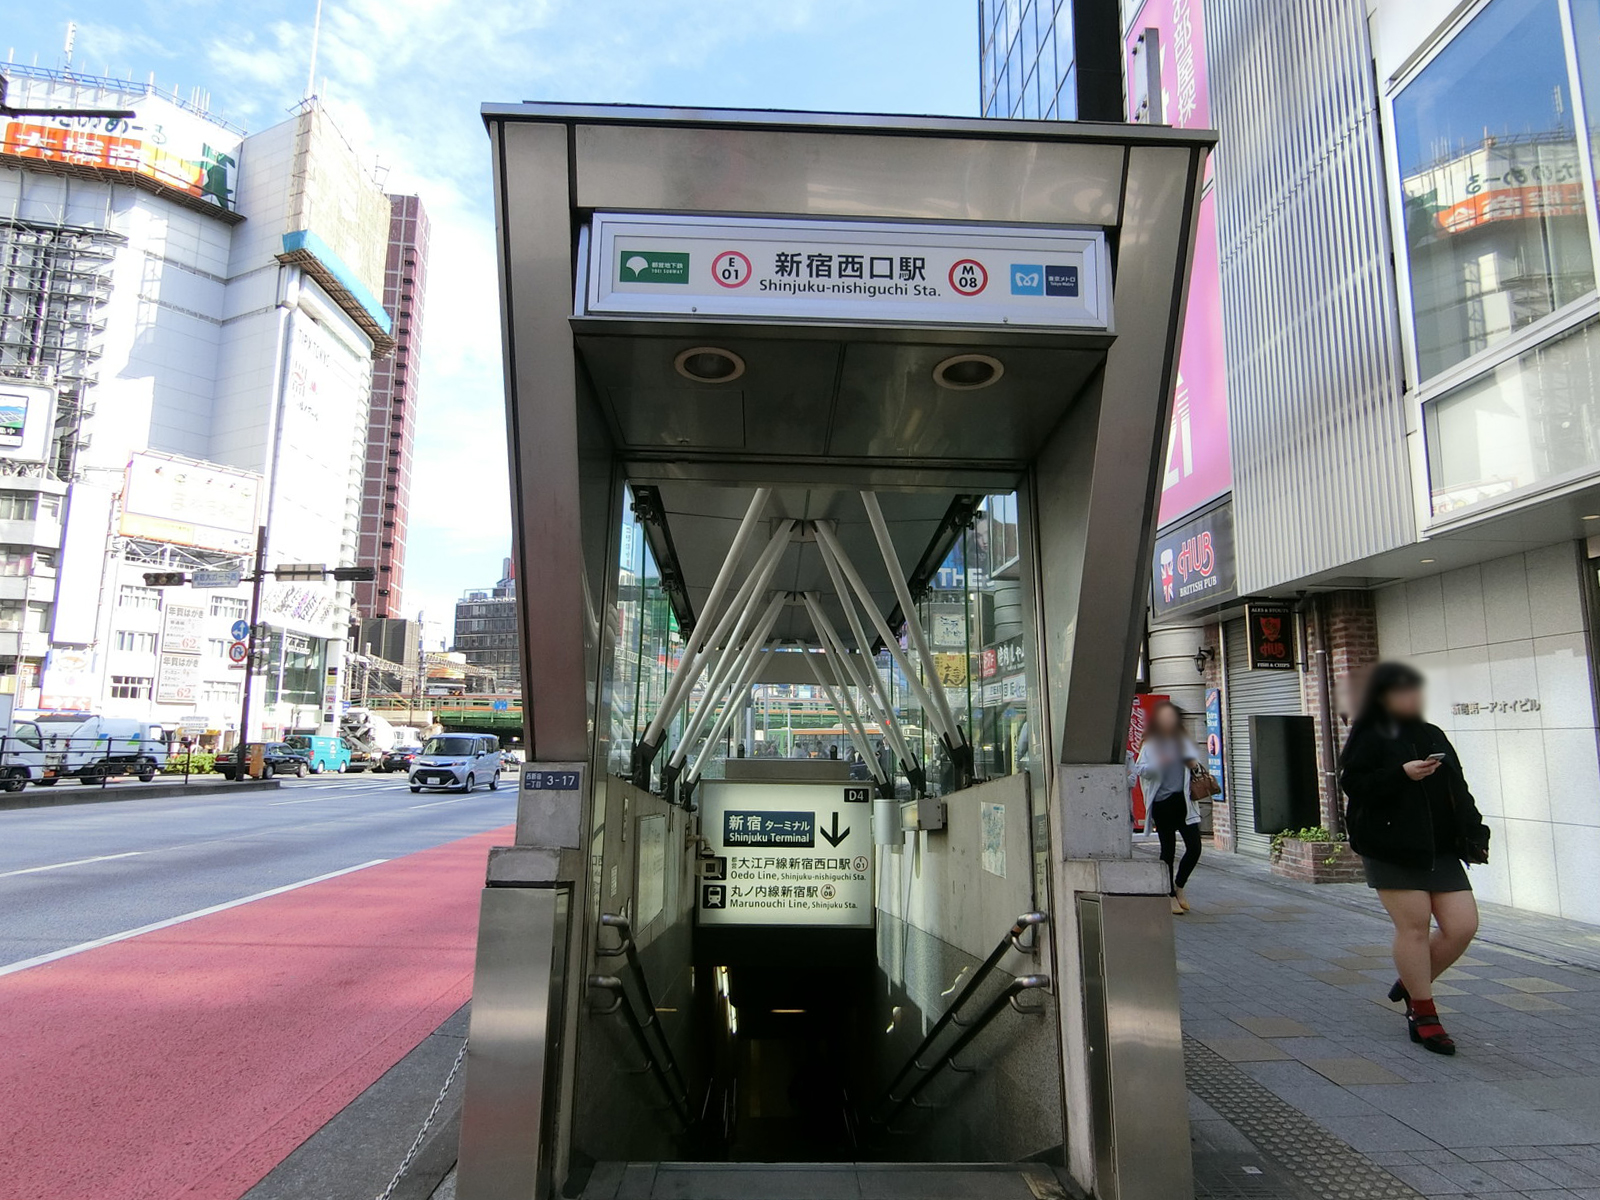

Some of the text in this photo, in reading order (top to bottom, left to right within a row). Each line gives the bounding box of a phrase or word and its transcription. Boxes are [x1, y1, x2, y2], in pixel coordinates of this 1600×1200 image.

[652, 261, 683, 269] 都営地下鉄
[728, 257, 736, 267] E
[775, 251, 926, 282] 新宿西口駅
[721, 268, 739, 280] 01
[962, 265, 974, 275] M
[759, 279, 941, 298] Shinjuku-nishiguchi Sta.
[958, 277, 977, 288] 08
[1178, 531, 1215, 583] HUB
[1179, 576, 1217, 597] BRITISH PUB
[168, 606, 204, 618] 年賀はがき
[181, 639, 197, 649] 62
[1259, 642, 1285, 658] HUB
[163, 657, 199, 668] 年賀はがき
[176, 688, 192, 698] 62
[526, 780, 541, 788] 一丁目
[546, 775, 576, 786] 3-17
[849, 790, 864, 801] D4
[728, 815, 810, 832] 新宿 ターミナル
[729, 832, 810, 844] Shinjuku Terminal
[738, 857, 851, 870] 大江戸線新宿西口駅
[730, 870, 755, 880] Oedo
[757, 871, 780, 881] Line,
[781, 874, 851, 882] Shinjuku-nishiguchi
[730, 885, 818, 898] 丸ノ内線新宿駅
[730, 898, 858, 910] Marunouchi Line, Shinjuku Sta.
